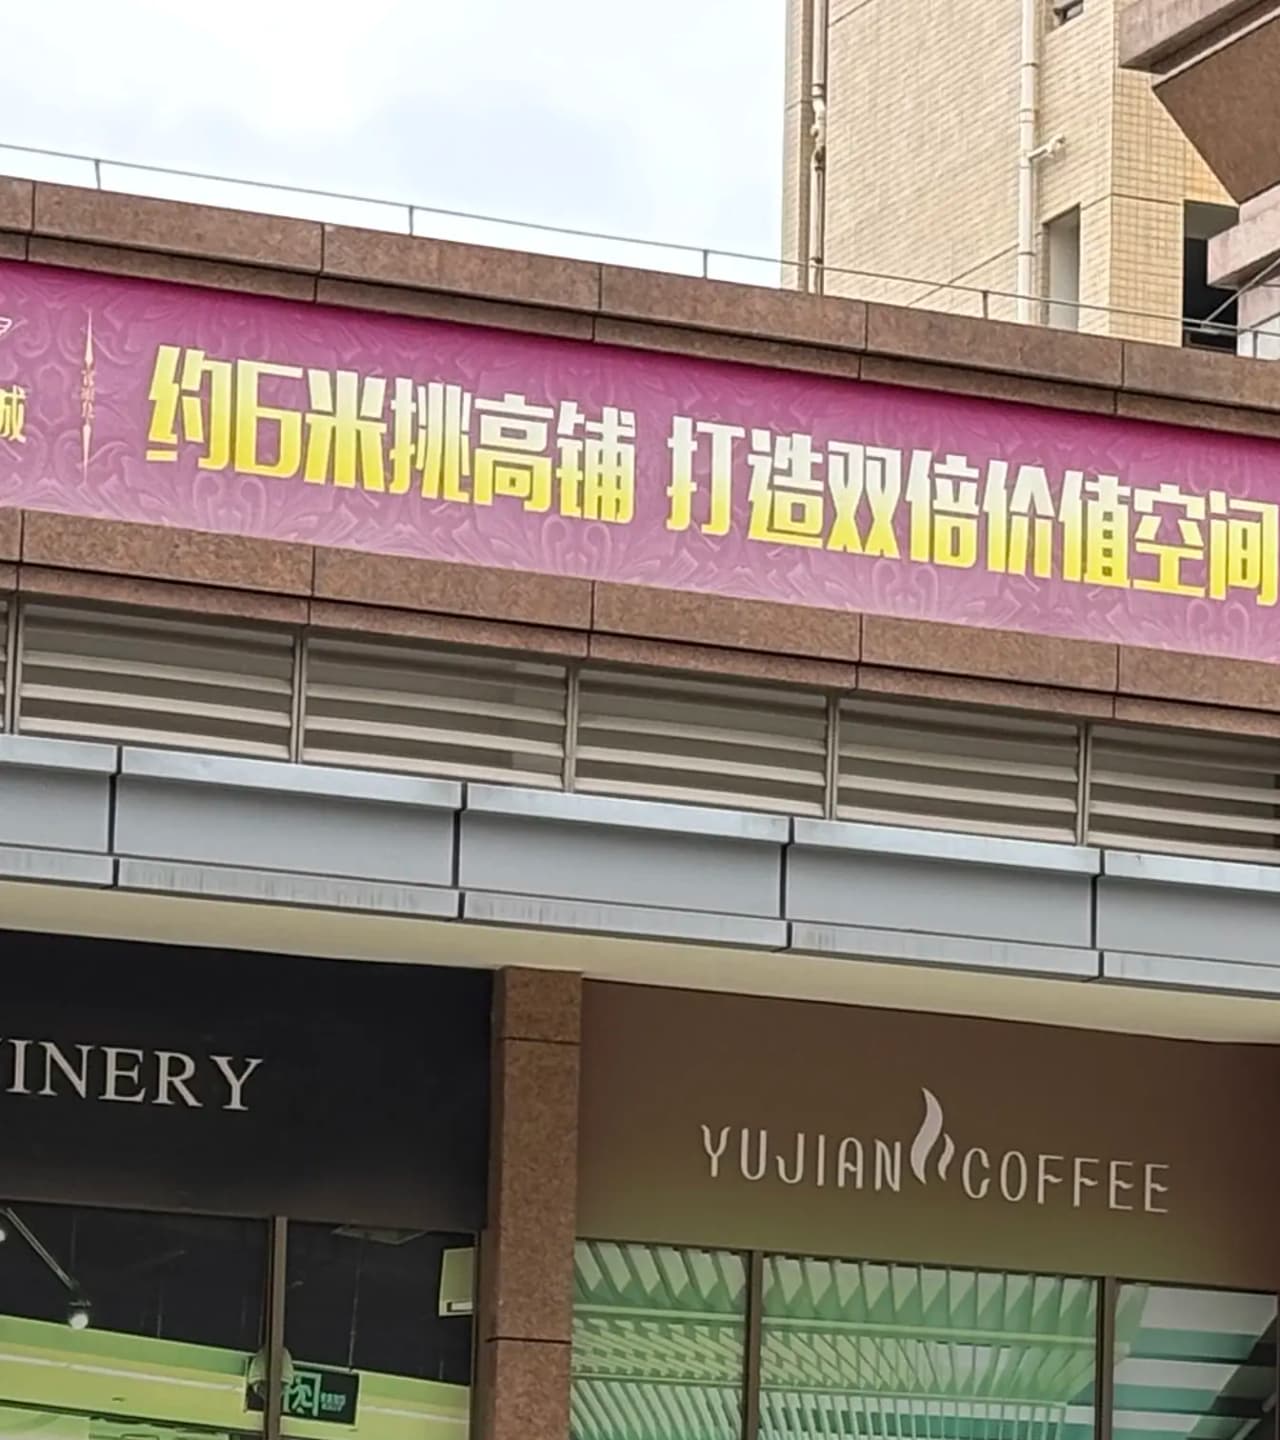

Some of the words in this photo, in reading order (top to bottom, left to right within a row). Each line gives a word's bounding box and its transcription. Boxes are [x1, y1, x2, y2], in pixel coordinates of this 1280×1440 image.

[146, 344, 636, 524] 约6米挑高铺
[666, 414, 1280, 606] 打造双倍价值空间
[0, 1038, 264, 1111] INERY
[702, 1124, 901, 1192] YUJIAN
[962, 1147, 1170, 1213] COFFEE
